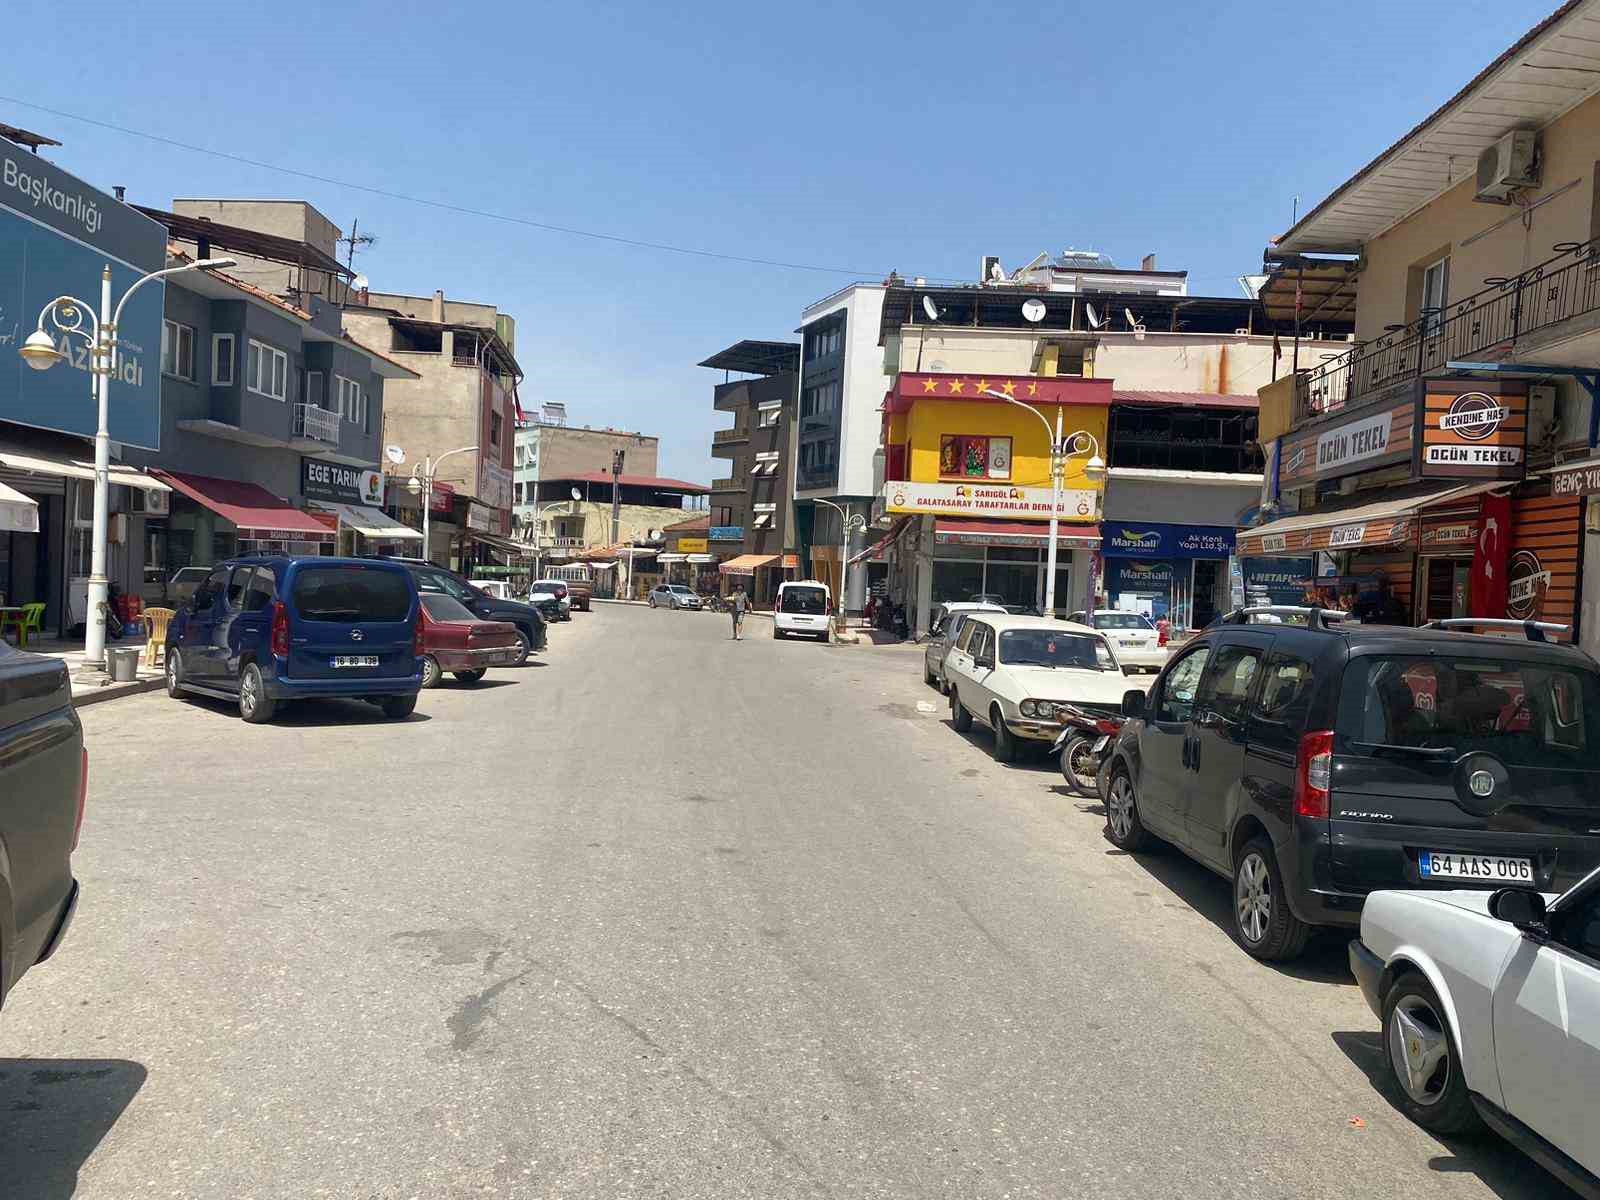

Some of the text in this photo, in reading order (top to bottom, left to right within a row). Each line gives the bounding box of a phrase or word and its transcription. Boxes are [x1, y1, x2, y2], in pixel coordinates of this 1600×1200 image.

[3, 158, 102, 233] Başkanlığı
[1486, 408, 1504, 421] HAS
[1351, 425, 1386, 456] TEKEL
[1473, 450, 1516, 462] TEKEL
[308, 463, 330, 484] EGE
[1554, 471, 1583, 496] GENÇ
[1112, 537, 1156, 548] Marshall
[1203, 535, 1222, 543] Kent
[1431, 855, 1453, 874] 64
[1459, 857, 1492, 876] AAS
[1497, 859, 1529, 878] 006
